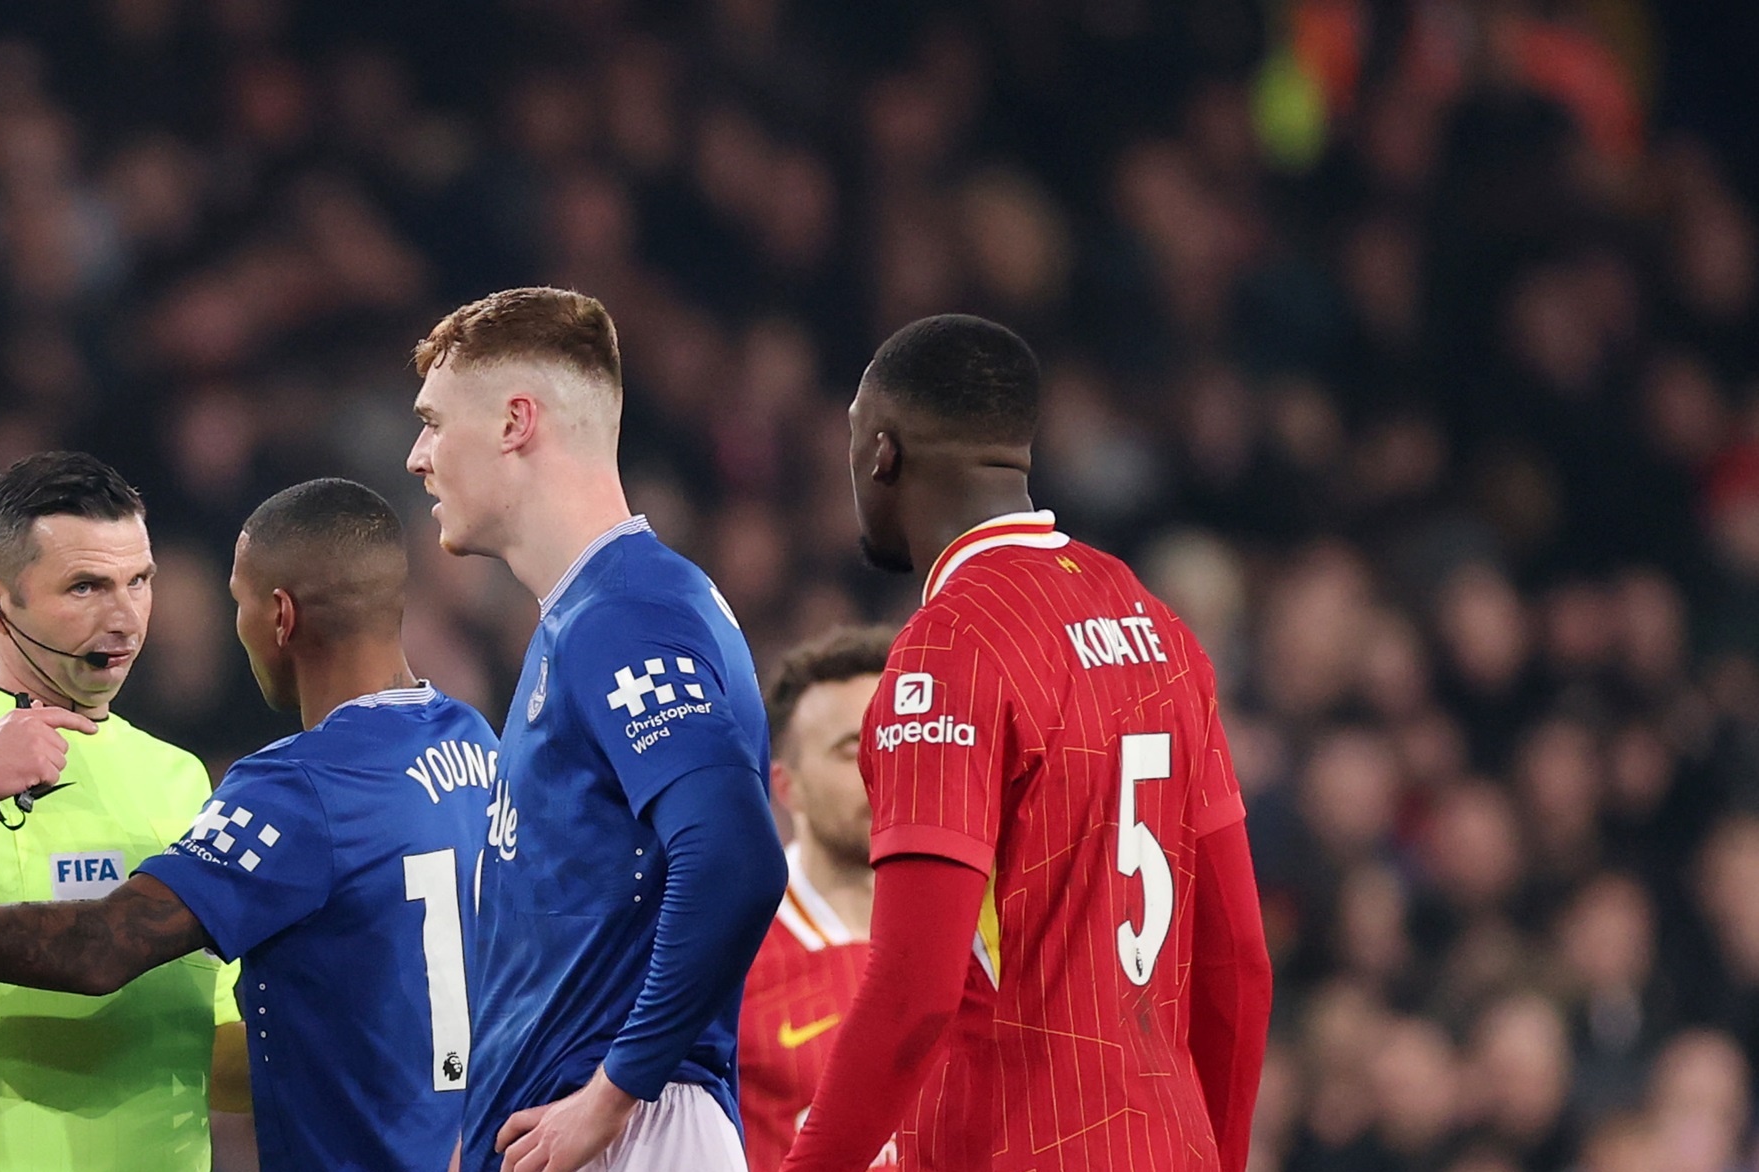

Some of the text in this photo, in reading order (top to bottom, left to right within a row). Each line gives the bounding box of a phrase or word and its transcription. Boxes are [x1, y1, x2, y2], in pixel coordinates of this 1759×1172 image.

[625, 702, 712, 738] Christopher
[631, 727, 671, 754] Ward
[57, 858, 119, 883] FIFA
[1117, 733, 1174, 986] 5
